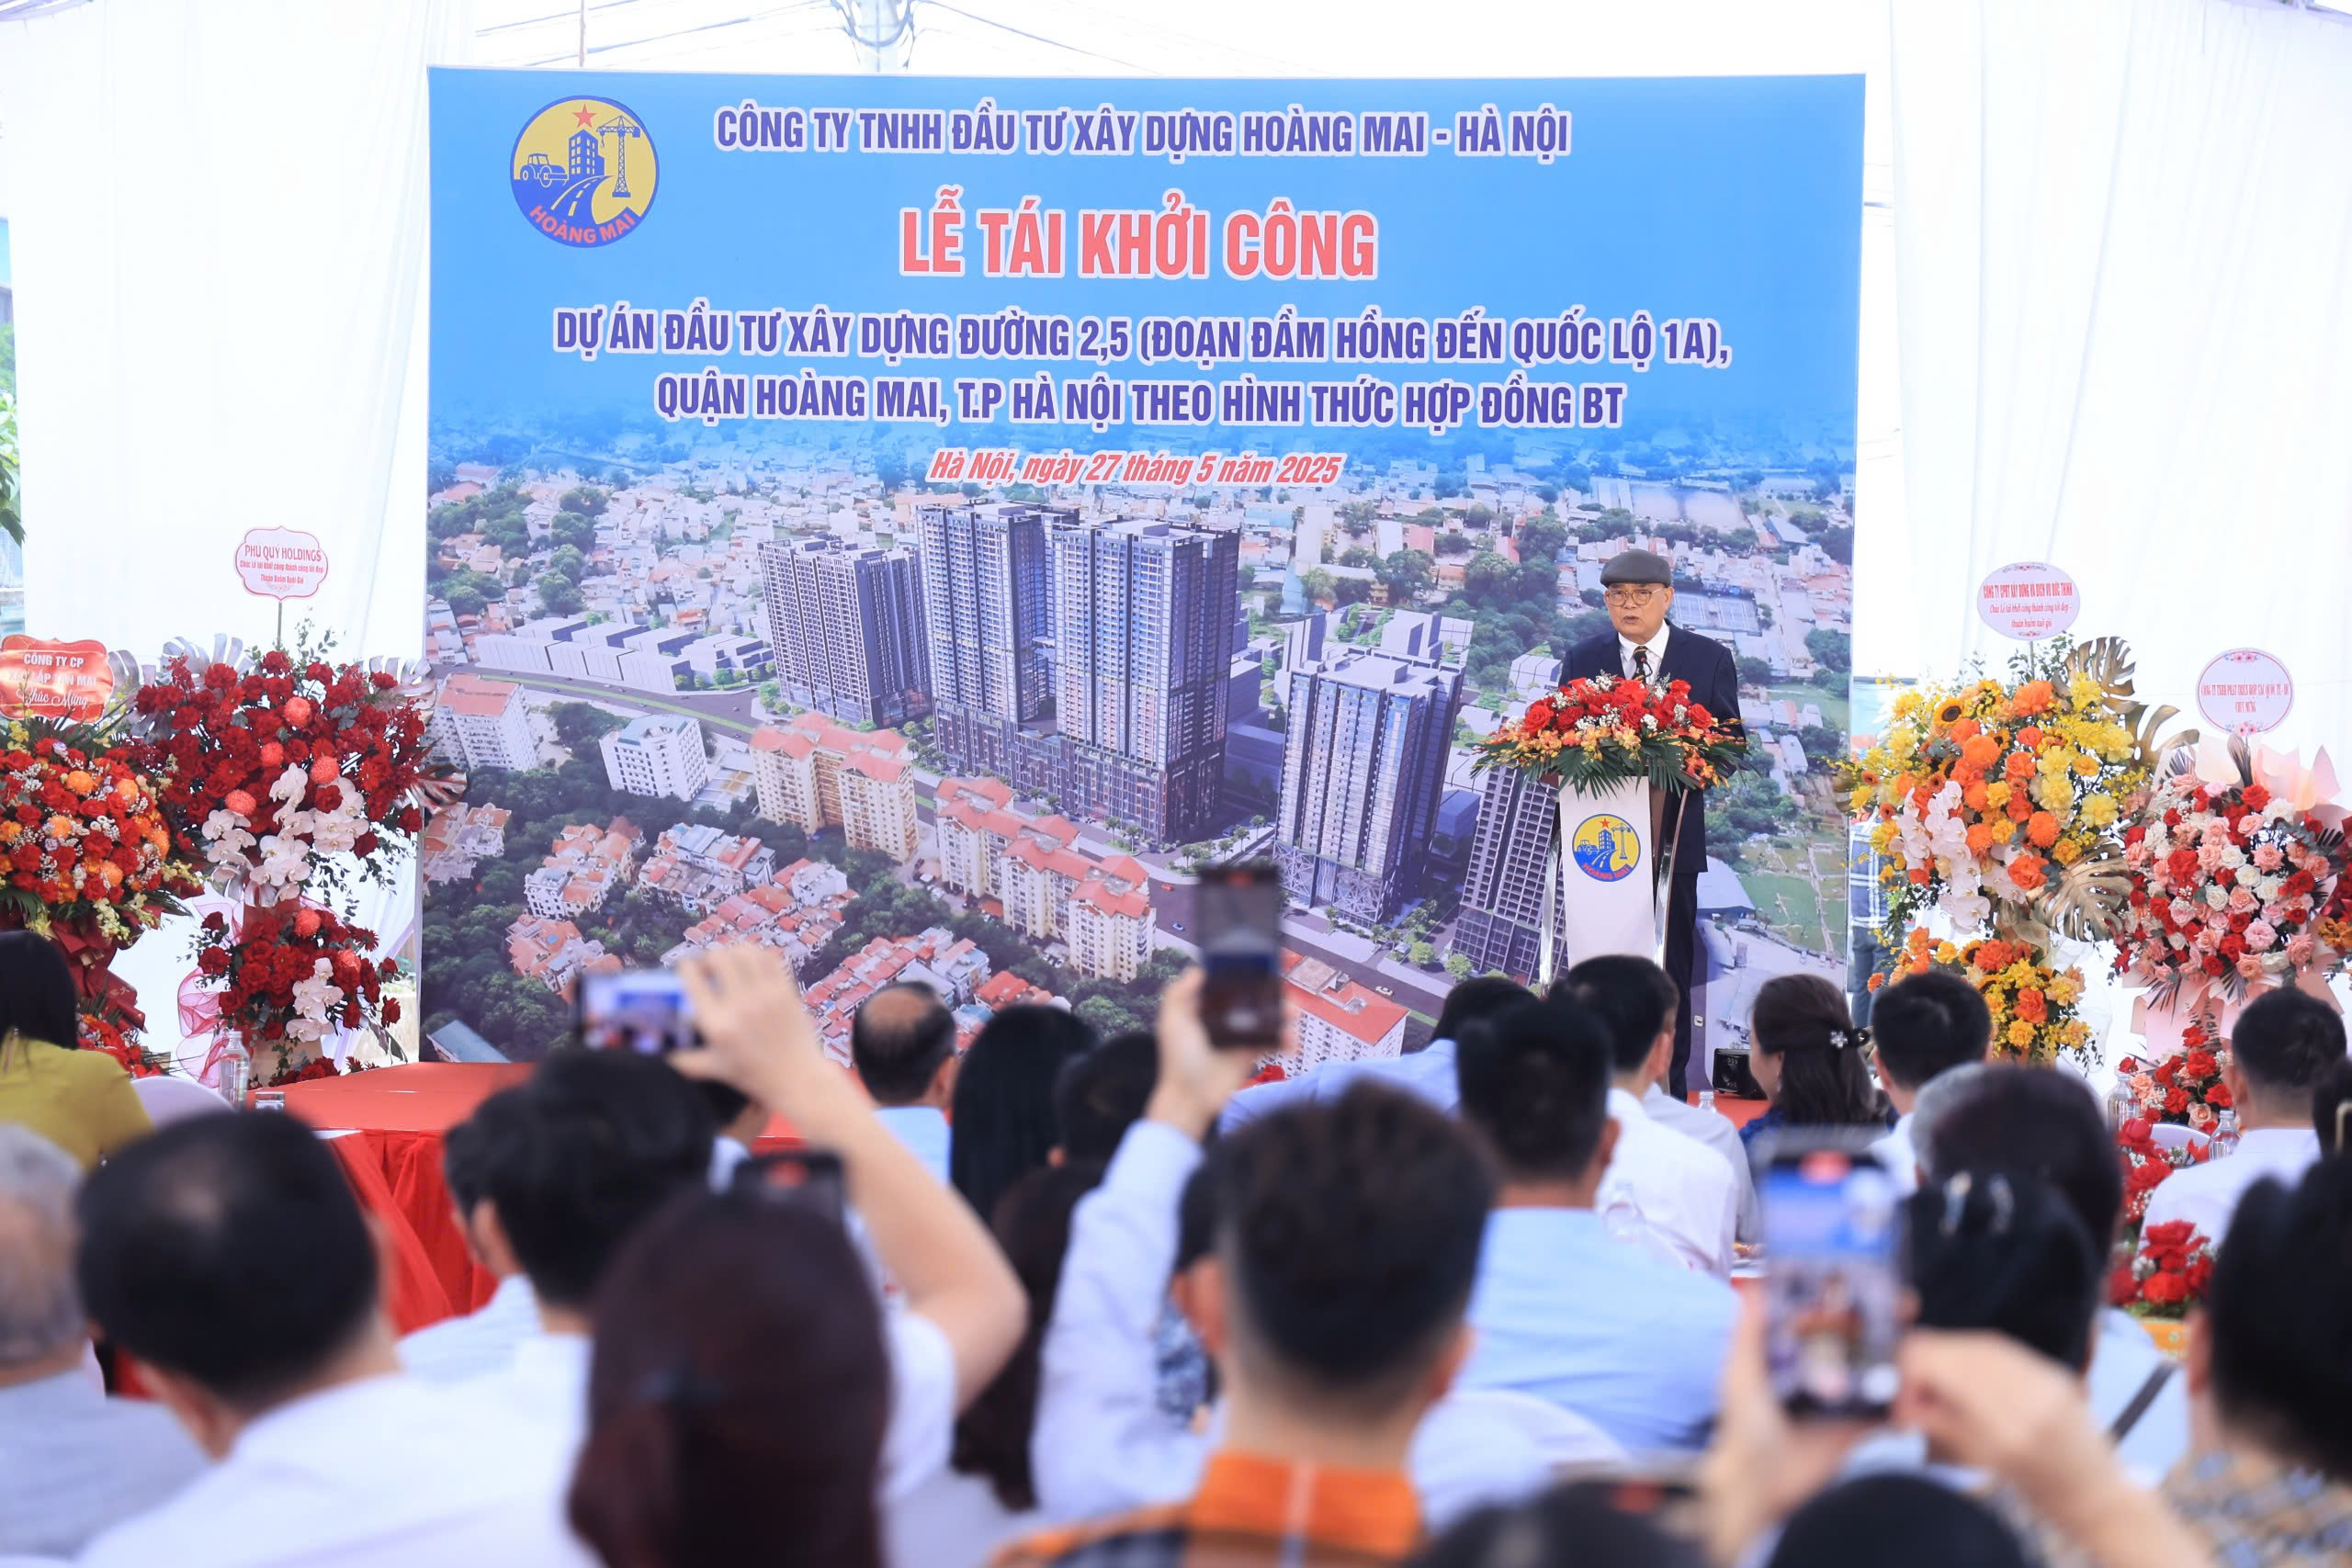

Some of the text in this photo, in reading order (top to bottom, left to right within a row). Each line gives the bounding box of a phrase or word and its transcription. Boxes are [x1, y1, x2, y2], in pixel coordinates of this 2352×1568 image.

[717, 102, 1568, 161] CÔNG TY TNHH ĐẦU TƯ XÂY DỰNG HOÀNG MAI - HÀ NỘI
[529, 205, 636, 243] HOÀNG MAI
[902, 187, 1375, 277] LỄ TÁI KHỞI CÔNG
[556, 300, 1729, 369] DỰ ÁN ĐẦU TƯ XÂY DỰNG ĐƯỜNG 2,5 (ĐOẠN ĐẦM HỒNG ĐẾN QUỐC LỘ 1A),
[657, 369, 1624, 433] QUẬN HOÀNG MAI, T.P HÀ NỘI THEO HÌNH THỨC HỢP ĐỒNG BT
[929, 450, 1342, 486] Hà Nội, ngày 27 tháng 5 năm 2025
[281, 547, 322, 562] HOLDINGS
[24, 652, 85, 668] CÔNG TY CP
